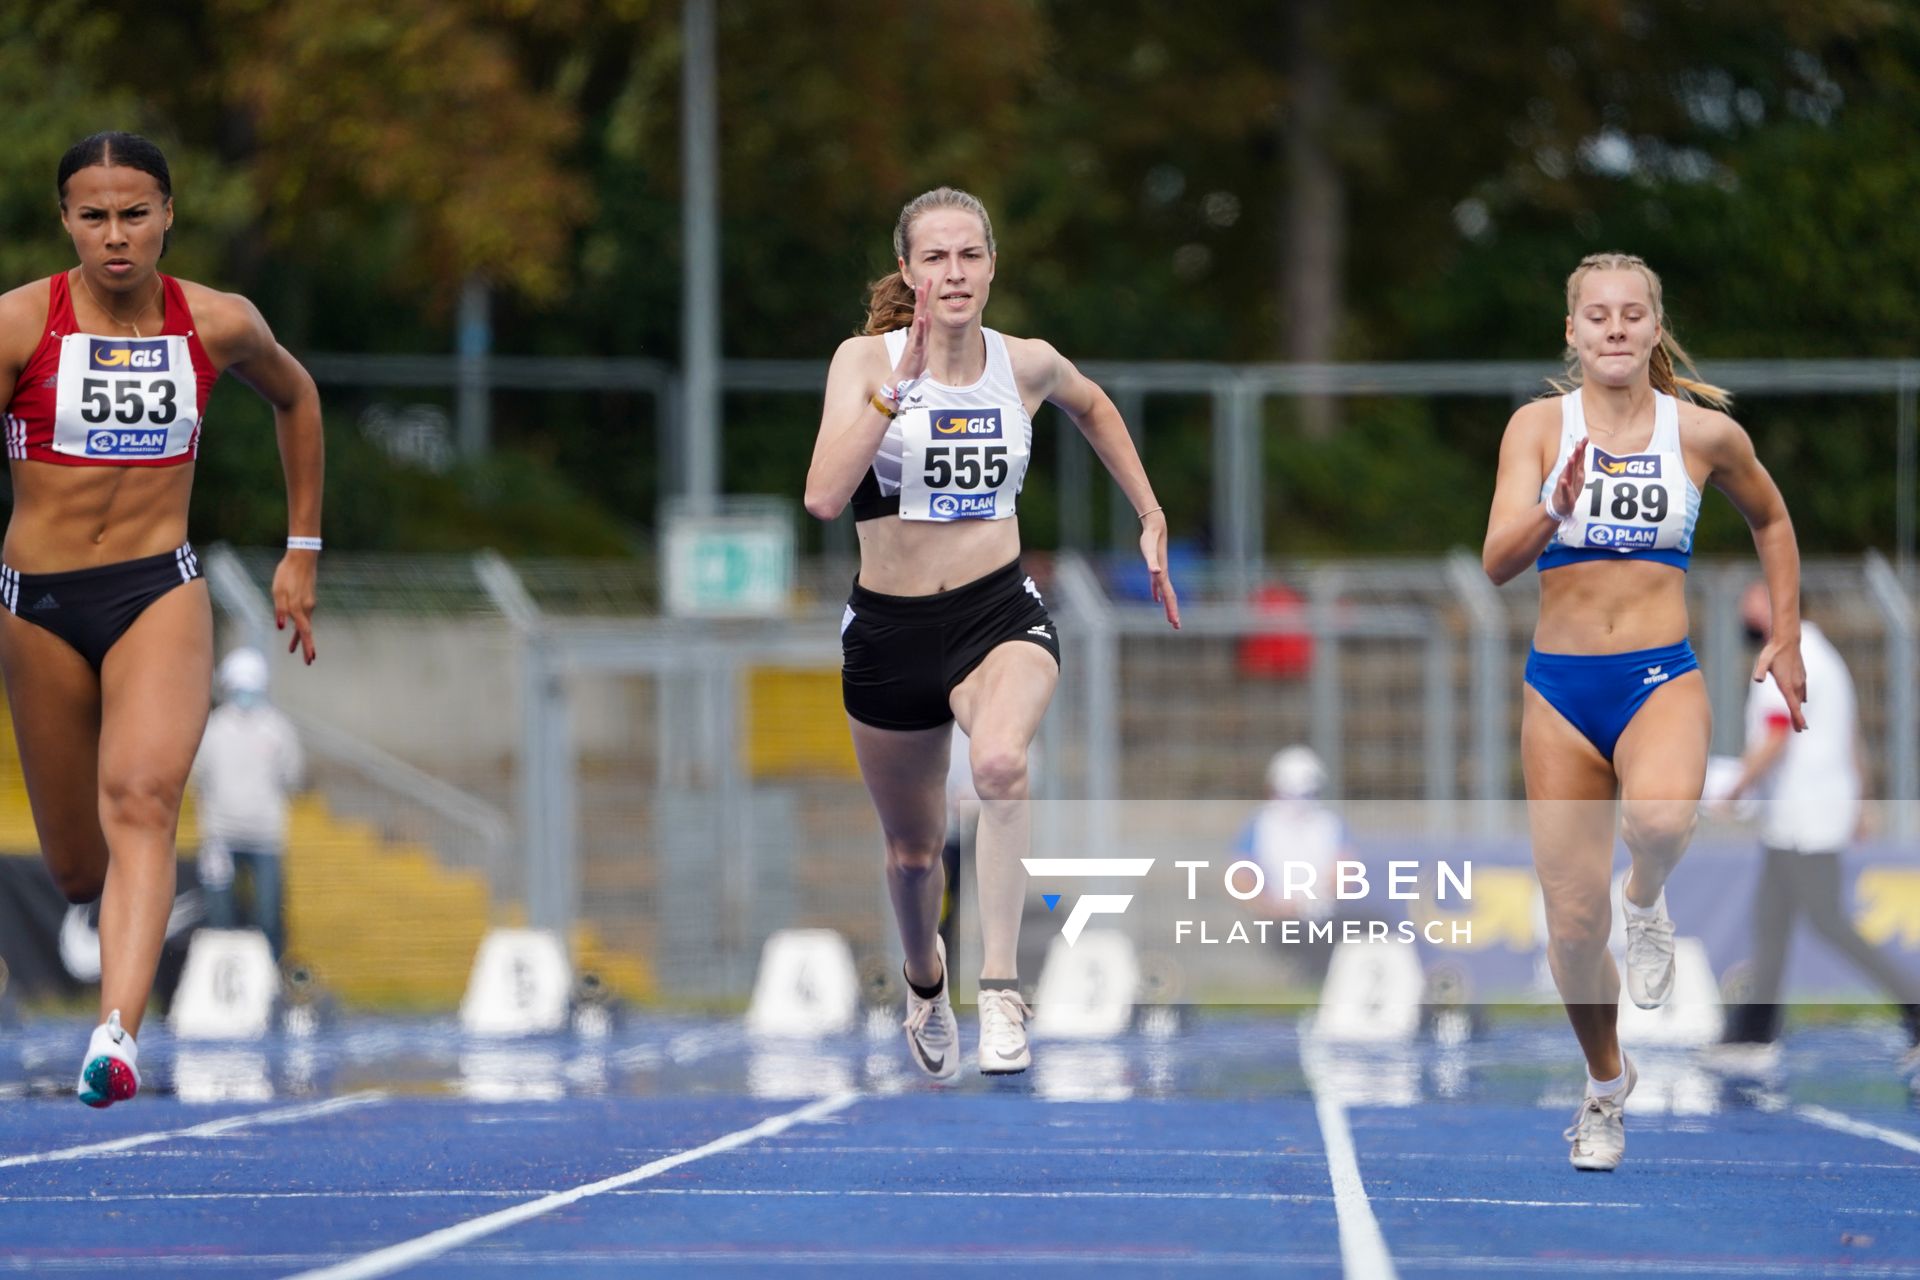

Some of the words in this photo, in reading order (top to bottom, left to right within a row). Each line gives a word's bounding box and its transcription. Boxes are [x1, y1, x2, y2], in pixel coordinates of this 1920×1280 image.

[130, 349, 162, 368] GLS
[81, 378, 177, 424] 553
[967, 417, 996, 434] GLS
[119, 433, 165, 446] PLAN
[923, 446, 1008, 489] 555
[1626, 460, 1656, 475] GLS
[961, 495, 994, 511] PLAN
[1585, 478, 1668, 523] 189
[1615, 528, 1655, 543] PLAN
